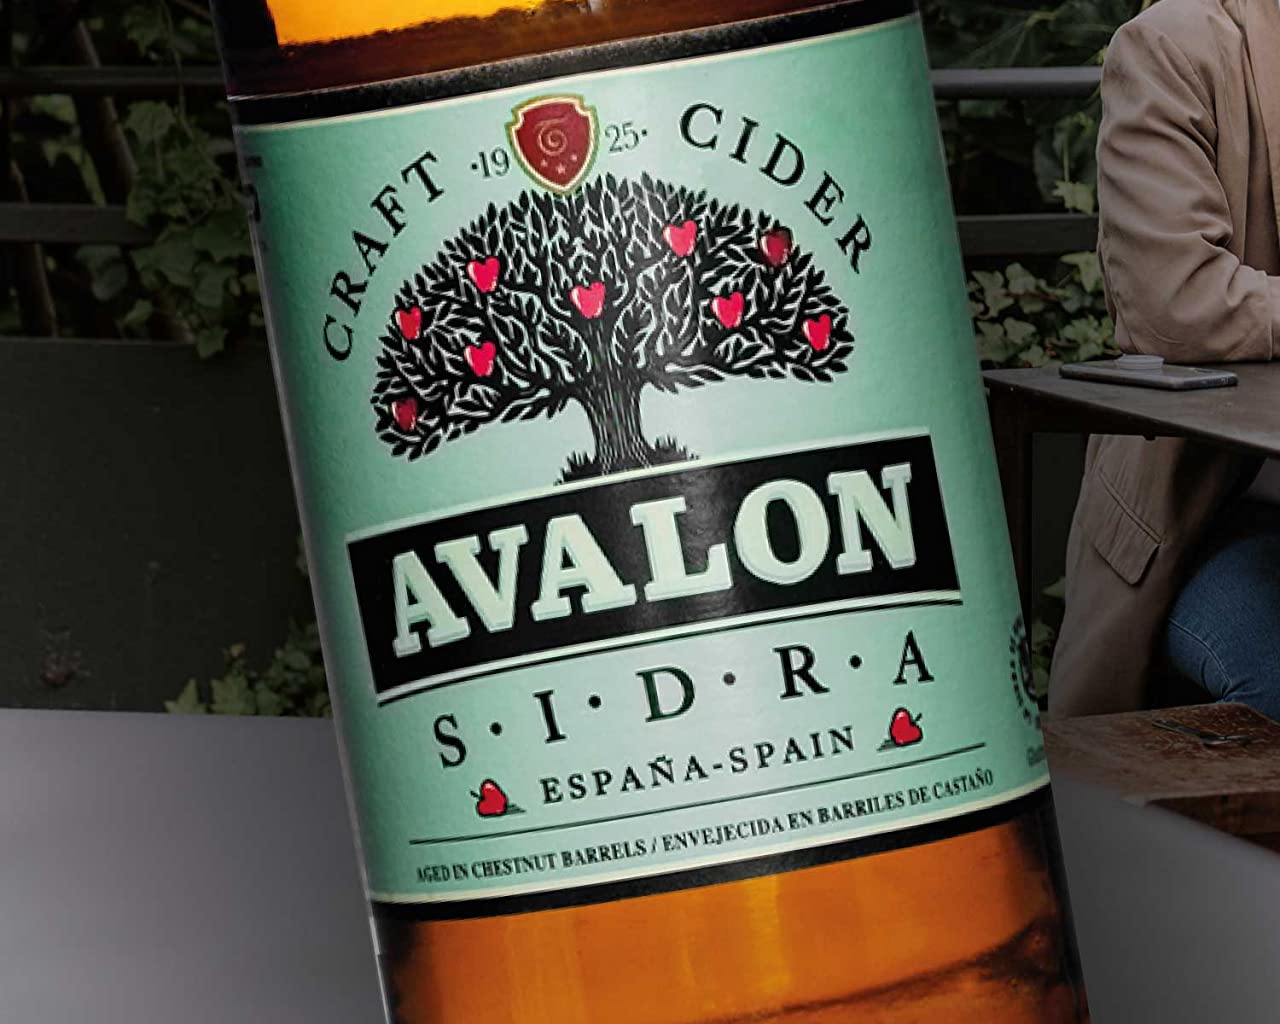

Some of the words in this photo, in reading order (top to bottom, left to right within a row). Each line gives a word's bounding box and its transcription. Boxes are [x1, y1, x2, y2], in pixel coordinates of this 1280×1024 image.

[325, 150, 444, 362] CRAFT
[678, 102, 874, 274] CIDER
[392, 463, 918, 657] AVALON
[416, 864, 450, 883] AGED
[453, 862, 469, 879] IN
[471, 853, 558, 878] CHESTNUT
[562, 838, 647, 868] BARRELS
[662, 817, 784, 852] ENVEJECIDA
[788, 808, 813, 830] EN
[817, 790, 905, 824] BARRILES
[908, 785, 931, 805] DE
[935, 768, 994, 799] CASTAÑO
[540, 726, 856, 805] ESPAÑA-SPAIN
